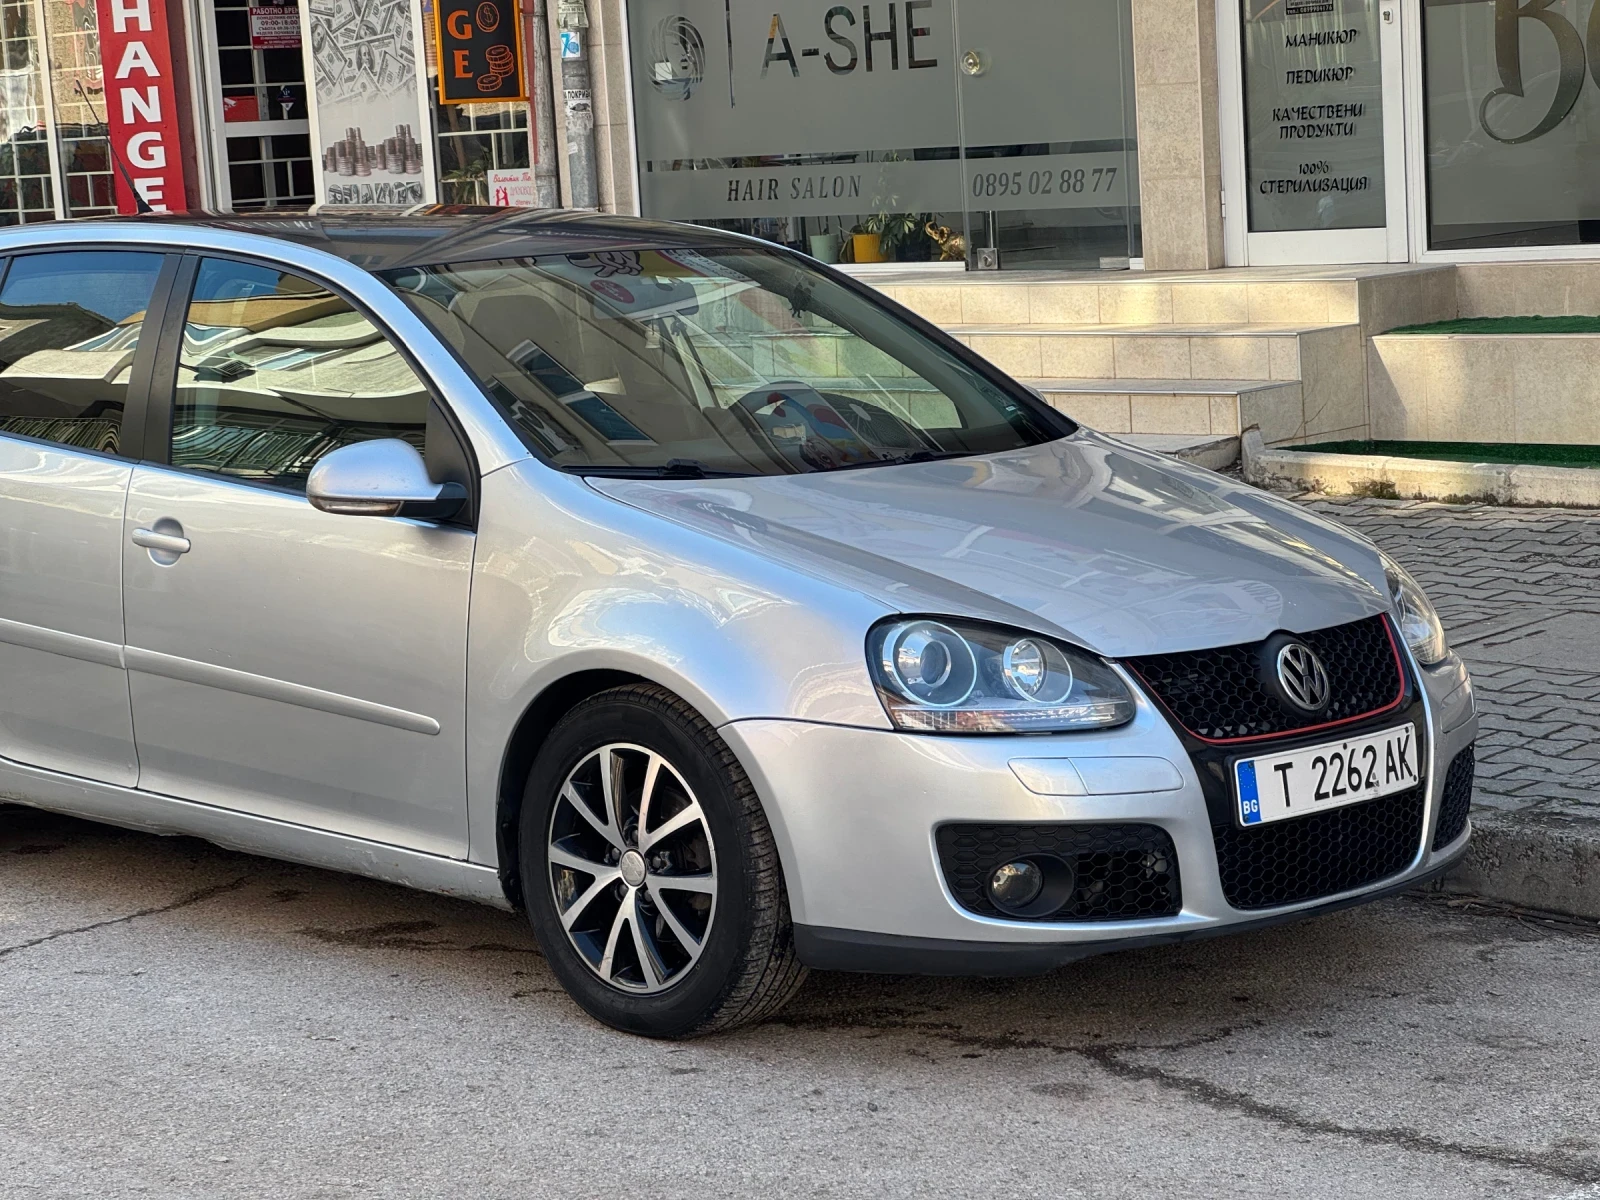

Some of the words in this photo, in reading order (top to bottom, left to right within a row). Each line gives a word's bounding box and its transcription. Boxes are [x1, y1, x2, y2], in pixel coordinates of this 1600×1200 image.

[759, 0, 938, 80] A-SHE
[1285, 29, 1357, 48] МАНИКЮР
[1286, 66, 1353, 84] ПЕДИКЮР
[1272, 103, 1363, 122] КАЧЕСТВЕНИ
[1279, 122, 1354, 139] ПРОДУКТИ
[1299, 160, 1329, 175] 100%
[727, 179, 779, 201] HAIR
[790, 175, 861, 199] SALON
[972, 171, 1022, 197] 0895
[1028, 170, 1053, 195] 02
[1059, 168, 1086, 194] 88
[1091, 167, 1118, 193] 77
[1260, 176, 1368, 194] СТЕРИЛИЗАЦИЯ
[1273, 761, 1294, 807] T
[1311, 745, 1377, 801] 2262
[1385, 734, 1414, 784] AK
[1243, 799, 1259, 814] BG
